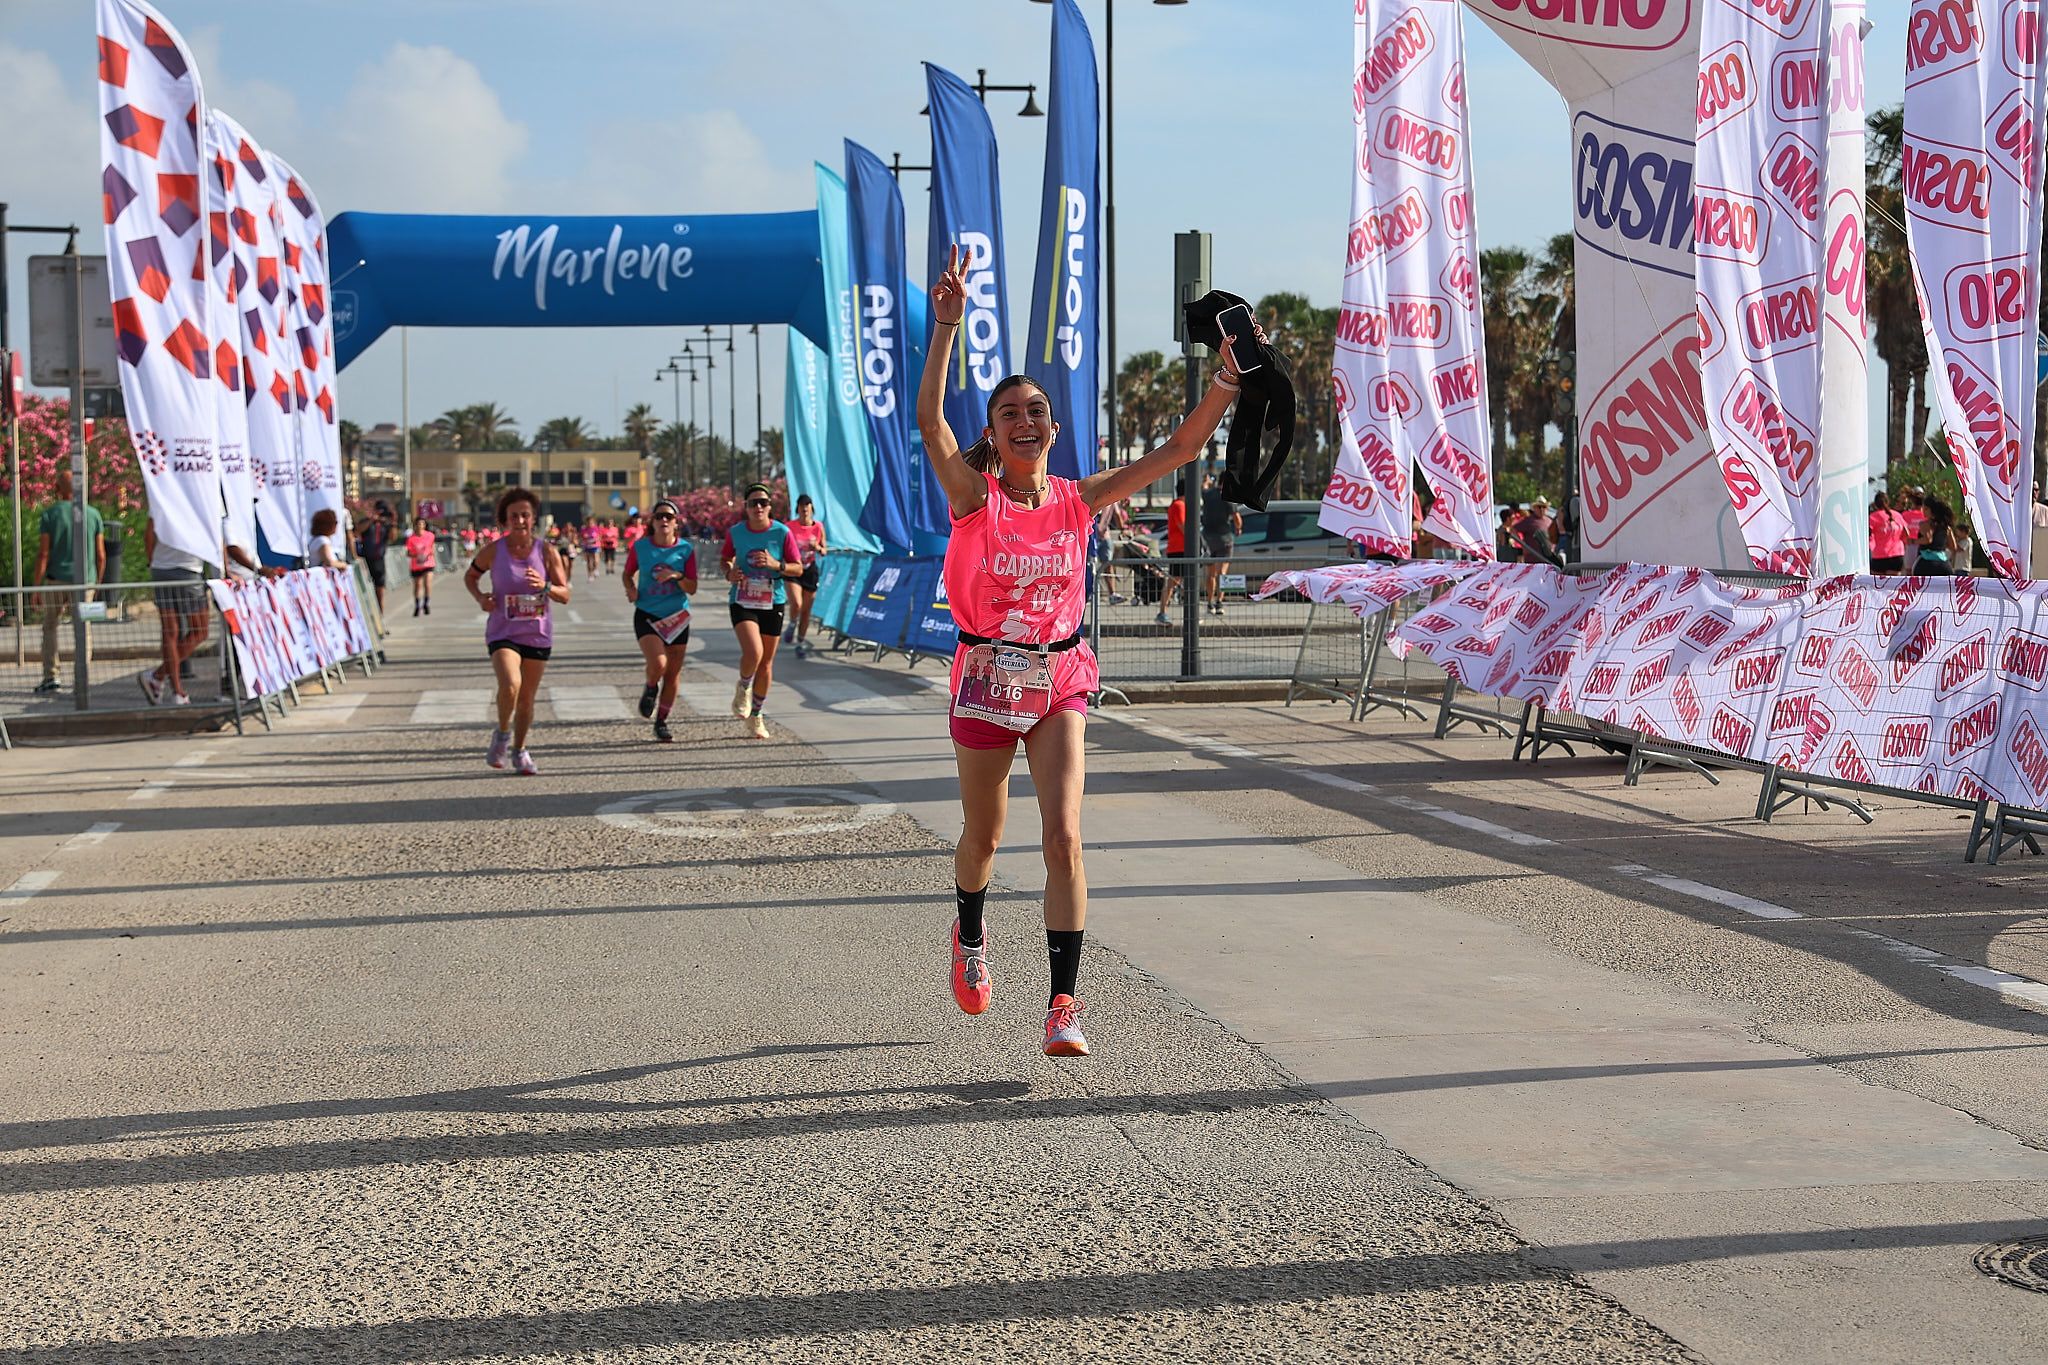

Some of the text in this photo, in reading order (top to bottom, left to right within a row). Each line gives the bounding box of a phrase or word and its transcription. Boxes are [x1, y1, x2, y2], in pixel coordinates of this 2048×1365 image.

[492, 224, 694, 311] Marlene
[1611, 590, 1661, 637] COSMO
[1638, 610, 1687, 646] COSMO
[1685, 611, 1730, 648] COSMO
[998, 656, 1028, 669] ASTURIANA
[1713, 615, 1774, 667] COSMO
[1893, 615, 1937, 683] COSMO
[1940, 635, 1986, 693] COSMO
[2001, 635, 2048, 683] COSMO
[990, 683, 1024, 701] 016
[1583, 667, 1622, 695] COSMO
[1629, 655, 1671, 697] COSMO
[1735, 654, 1783, 692] COSMO
[1837, 646, 1878, 708] COSMO
[965, 711, 994, 722] OYSHO
[1672, 671, 1701, 735] COSMO
[1711, 708, 1752, 757] COSMO
[1882, 722, 1929, 759] COSMO
[1949, 700, 1998, 757] COSMO
